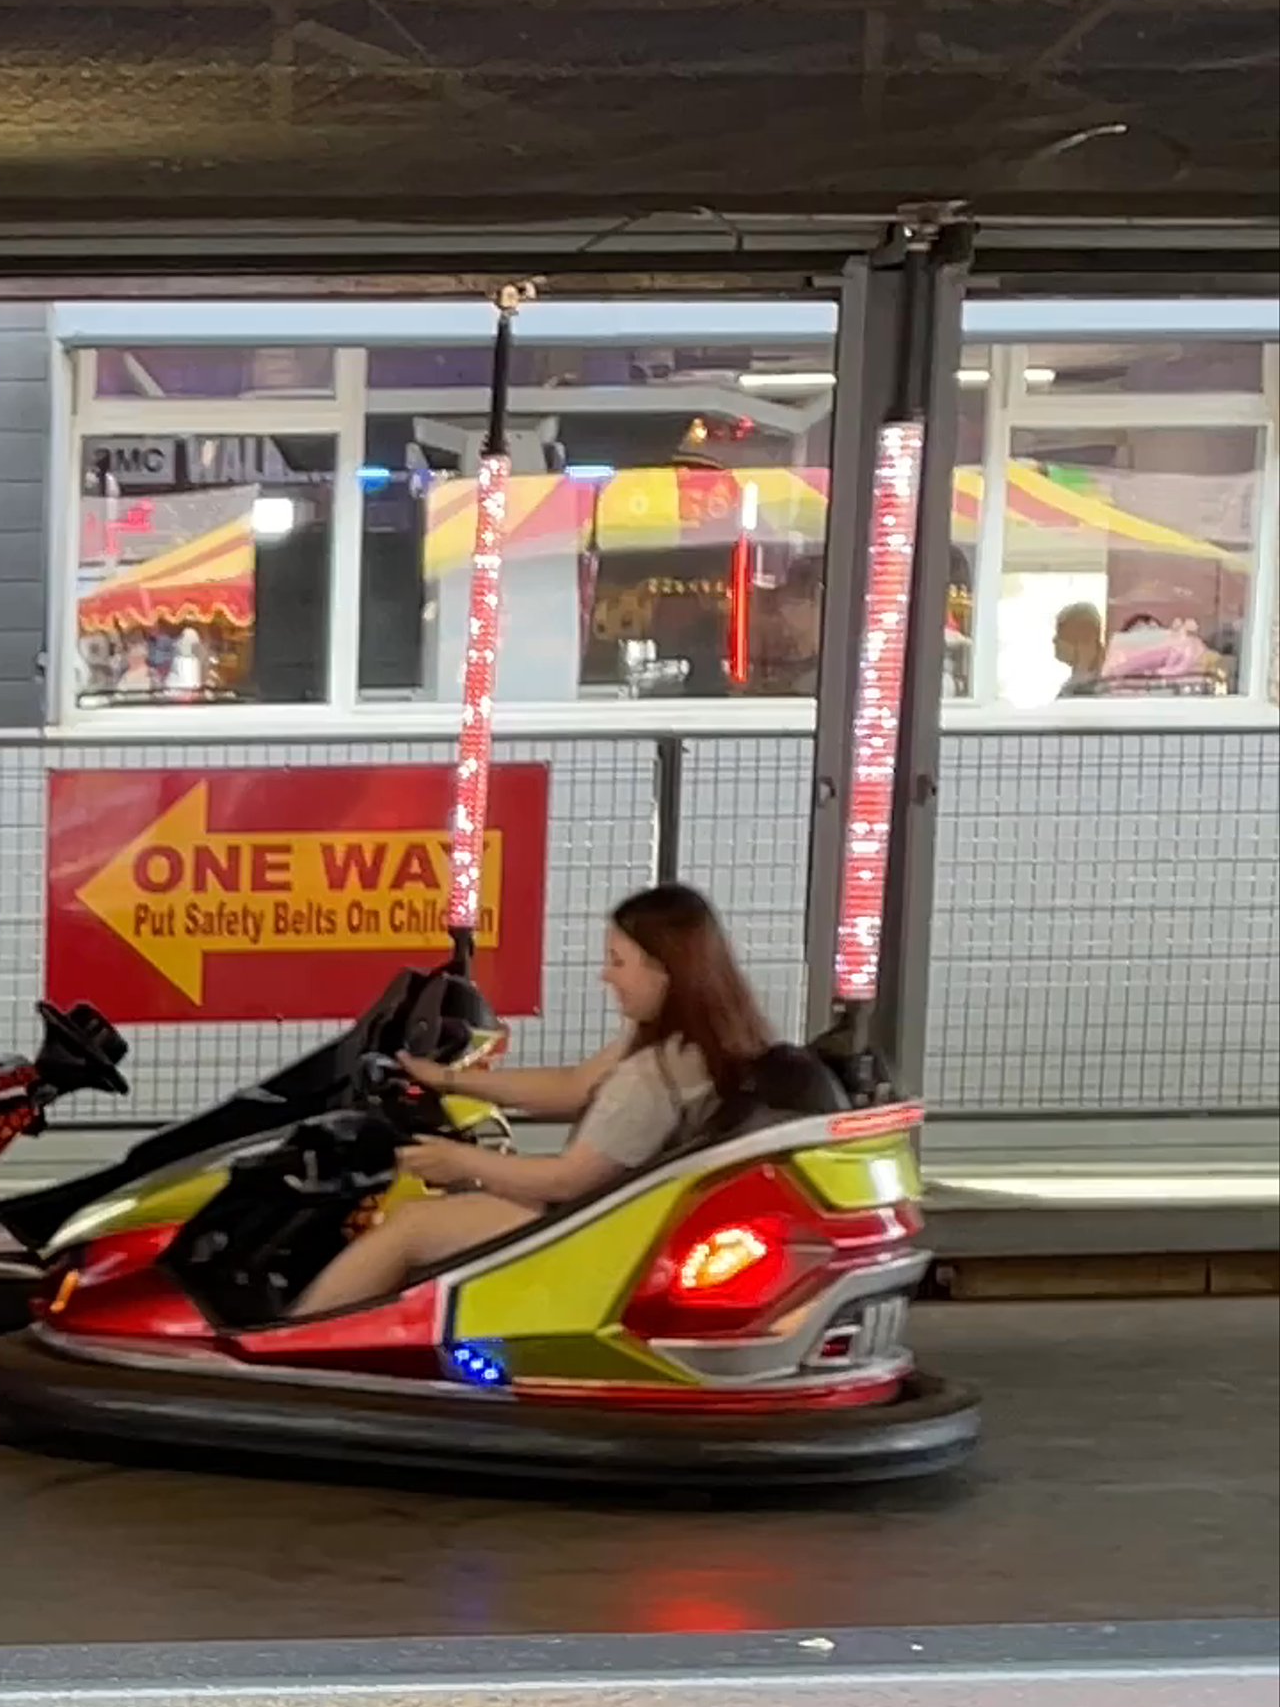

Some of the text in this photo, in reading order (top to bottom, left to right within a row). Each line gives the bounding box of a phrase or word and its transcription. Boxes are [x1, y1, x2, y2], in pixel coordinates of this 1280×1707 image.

[133, 844, 292, 893] ONE
[133, 898, 493, 944] Put Safety Belts On Chiln
